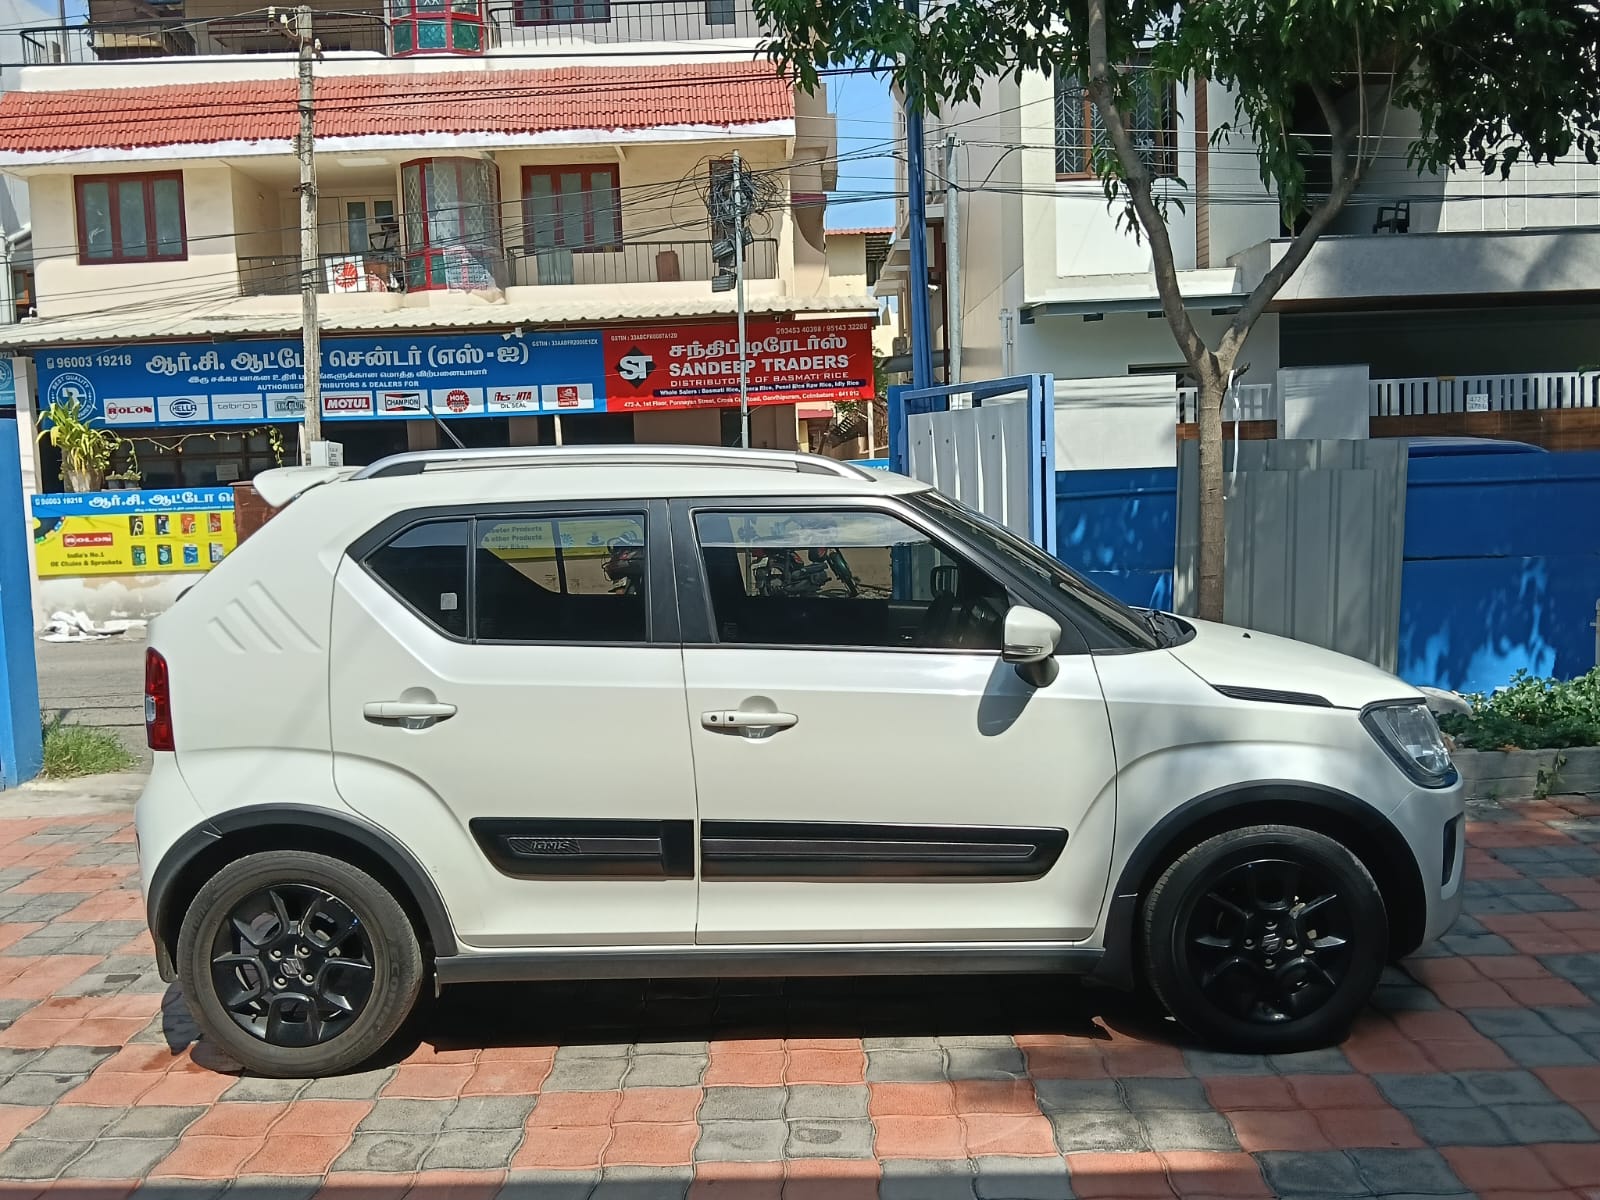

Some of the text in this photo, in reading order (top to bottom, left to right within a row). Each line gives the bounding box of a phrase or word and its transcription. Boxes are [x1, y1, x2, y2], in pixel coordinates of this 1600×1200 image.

[56, 354, 132, 369] 96003 19218
[145, 350, 226, 376] ஆர்.சி.
[329, 345, 422, 367] சென்டர்
[669, 354, 849, 377] SANDEEP TRADERS
[52, 375, 90, 390] BEST QUALITY
[369, 380, 402, 388] DEALERS
[671, 377, 751, 387] DISTRIBUTORS
[755, 376, 768, 384] OF
[773, 373, 820, 382] BASMATI
[172, 404, 197, 412] HELLA
[326, 398, 368, 409] MOTUL
[386, 398, 419, 406] CHAMPION
[107, 405, 153, 415] ROLON
[149, 491, 215, 506] ஆட்டோ
